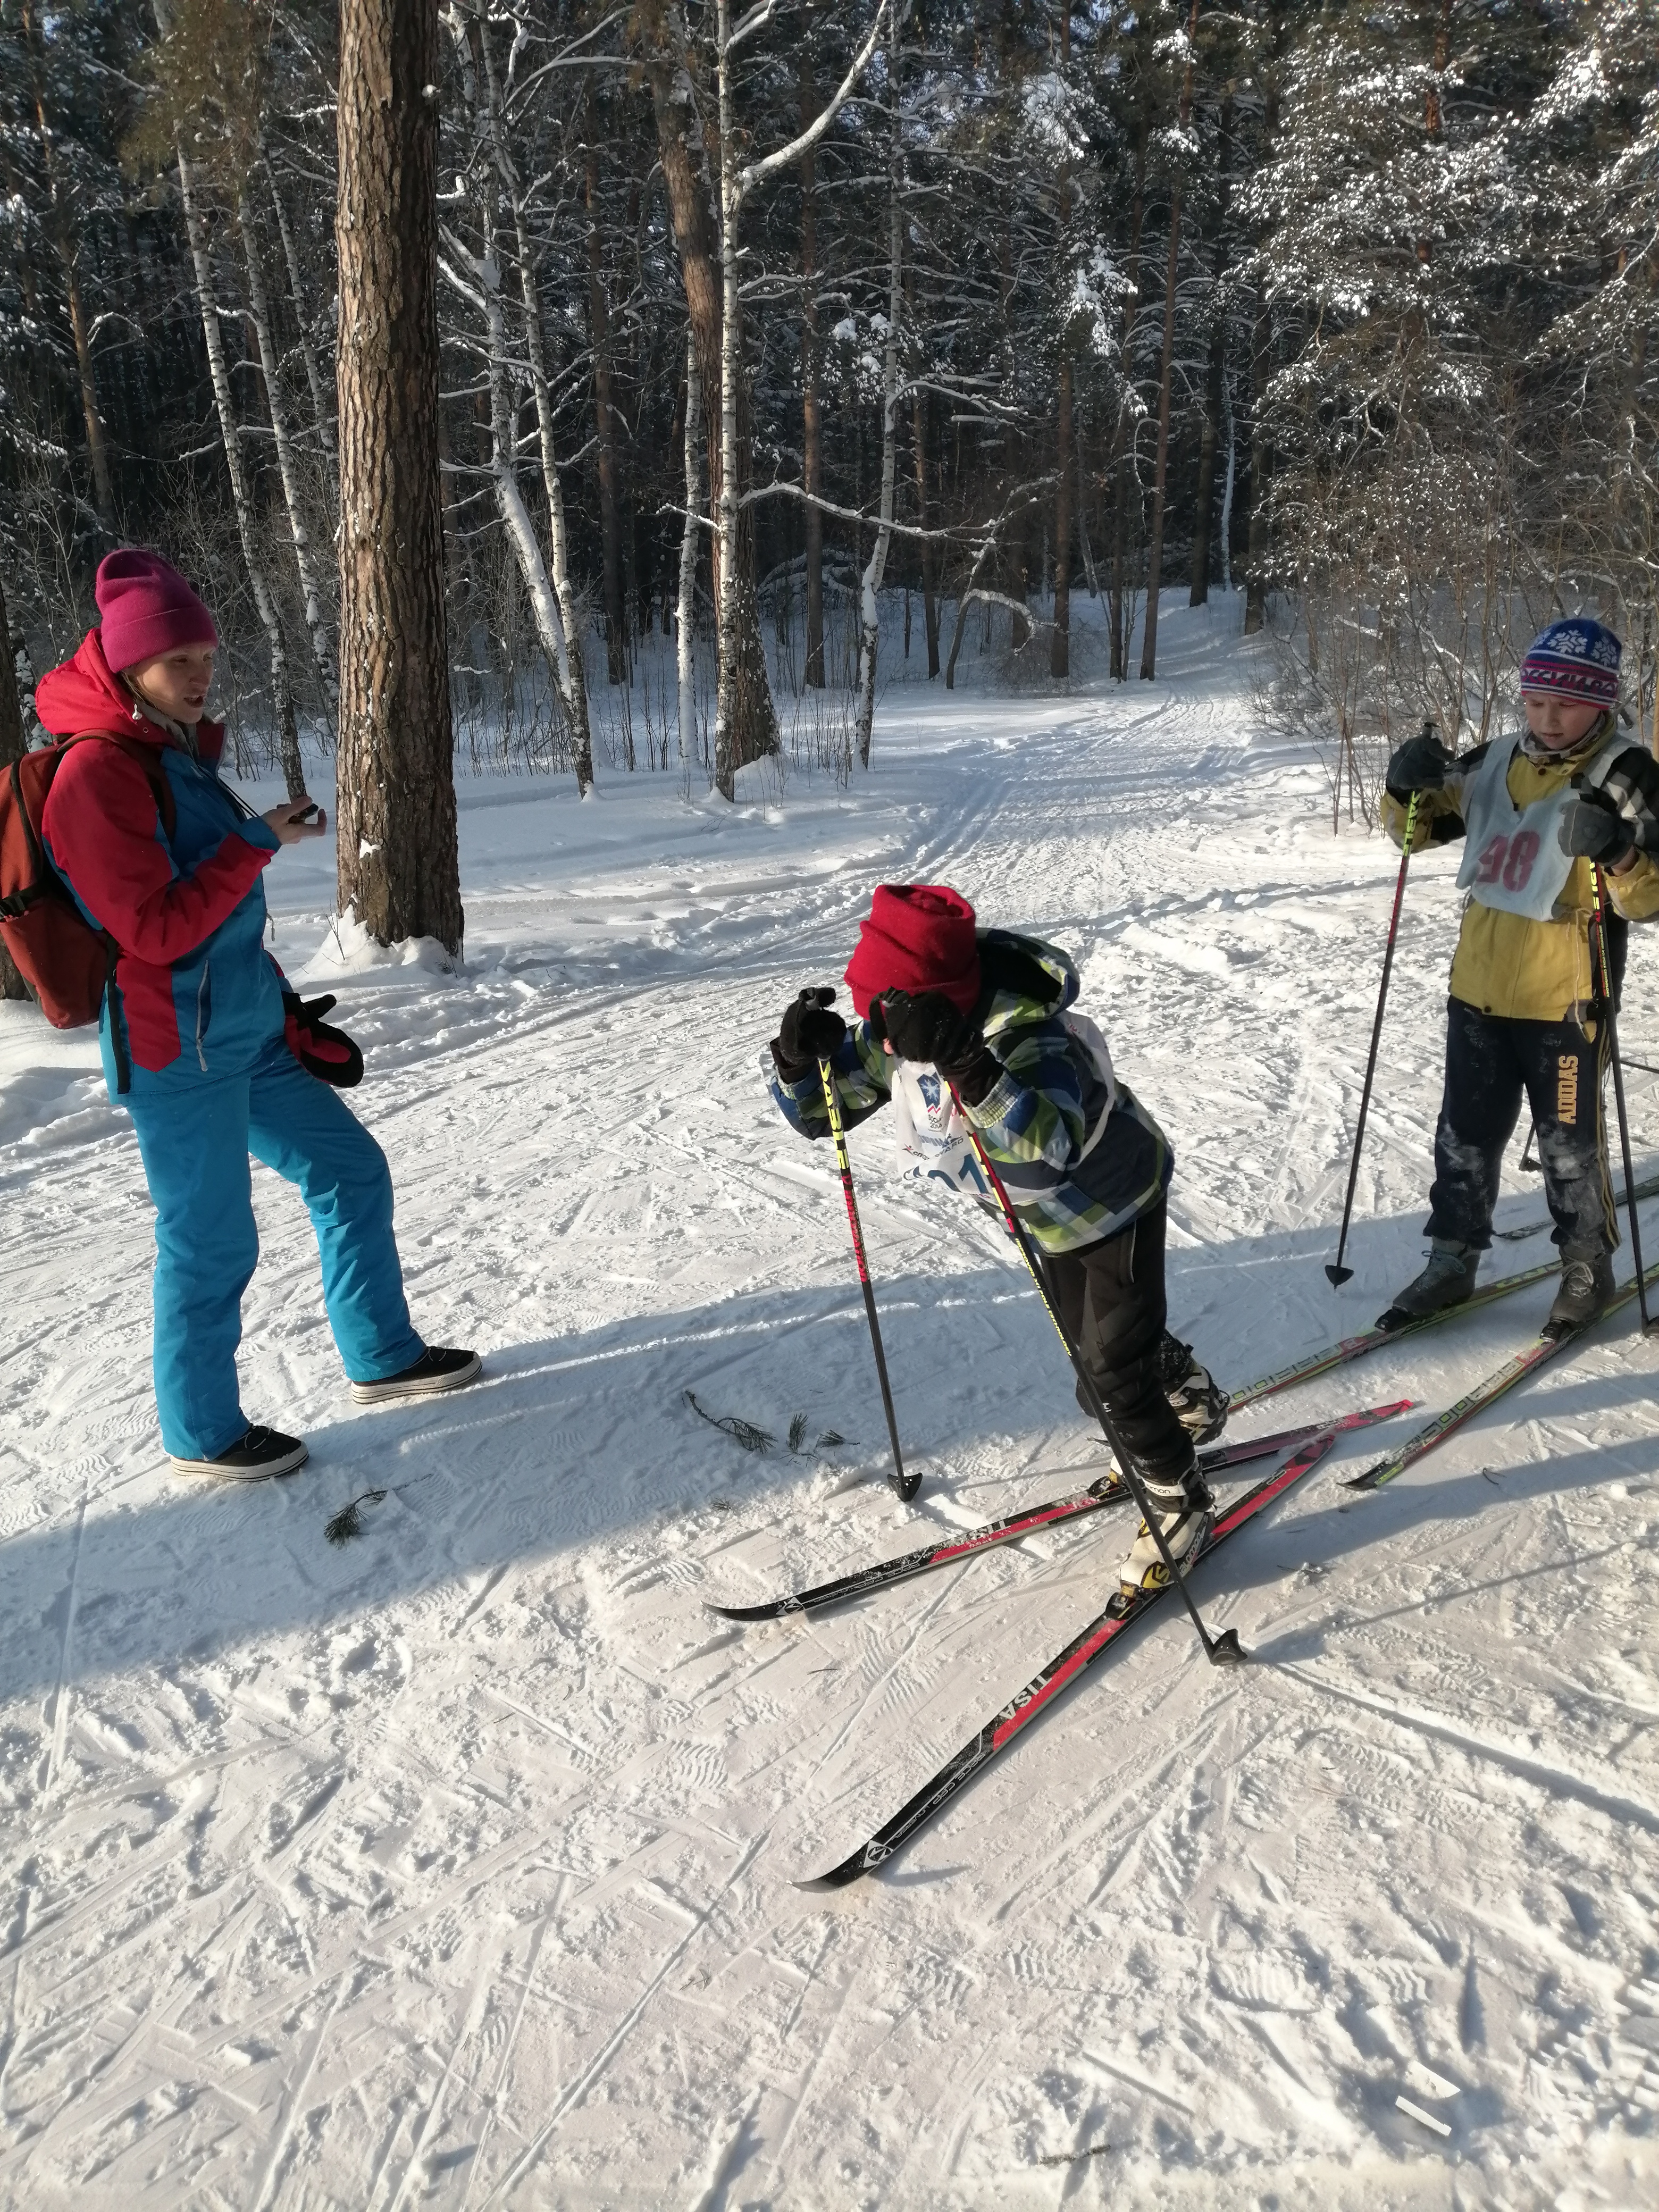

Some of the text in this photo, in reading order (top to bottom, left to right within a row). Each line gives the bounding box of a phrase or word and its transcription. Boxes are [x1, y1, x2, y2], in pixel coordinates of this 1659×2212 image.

[1558, 1055, 1579, 1125] ADIDAS
[998, 1674, 1052, 1720] TISA
[933, 1782, 956, 1805] CAP
